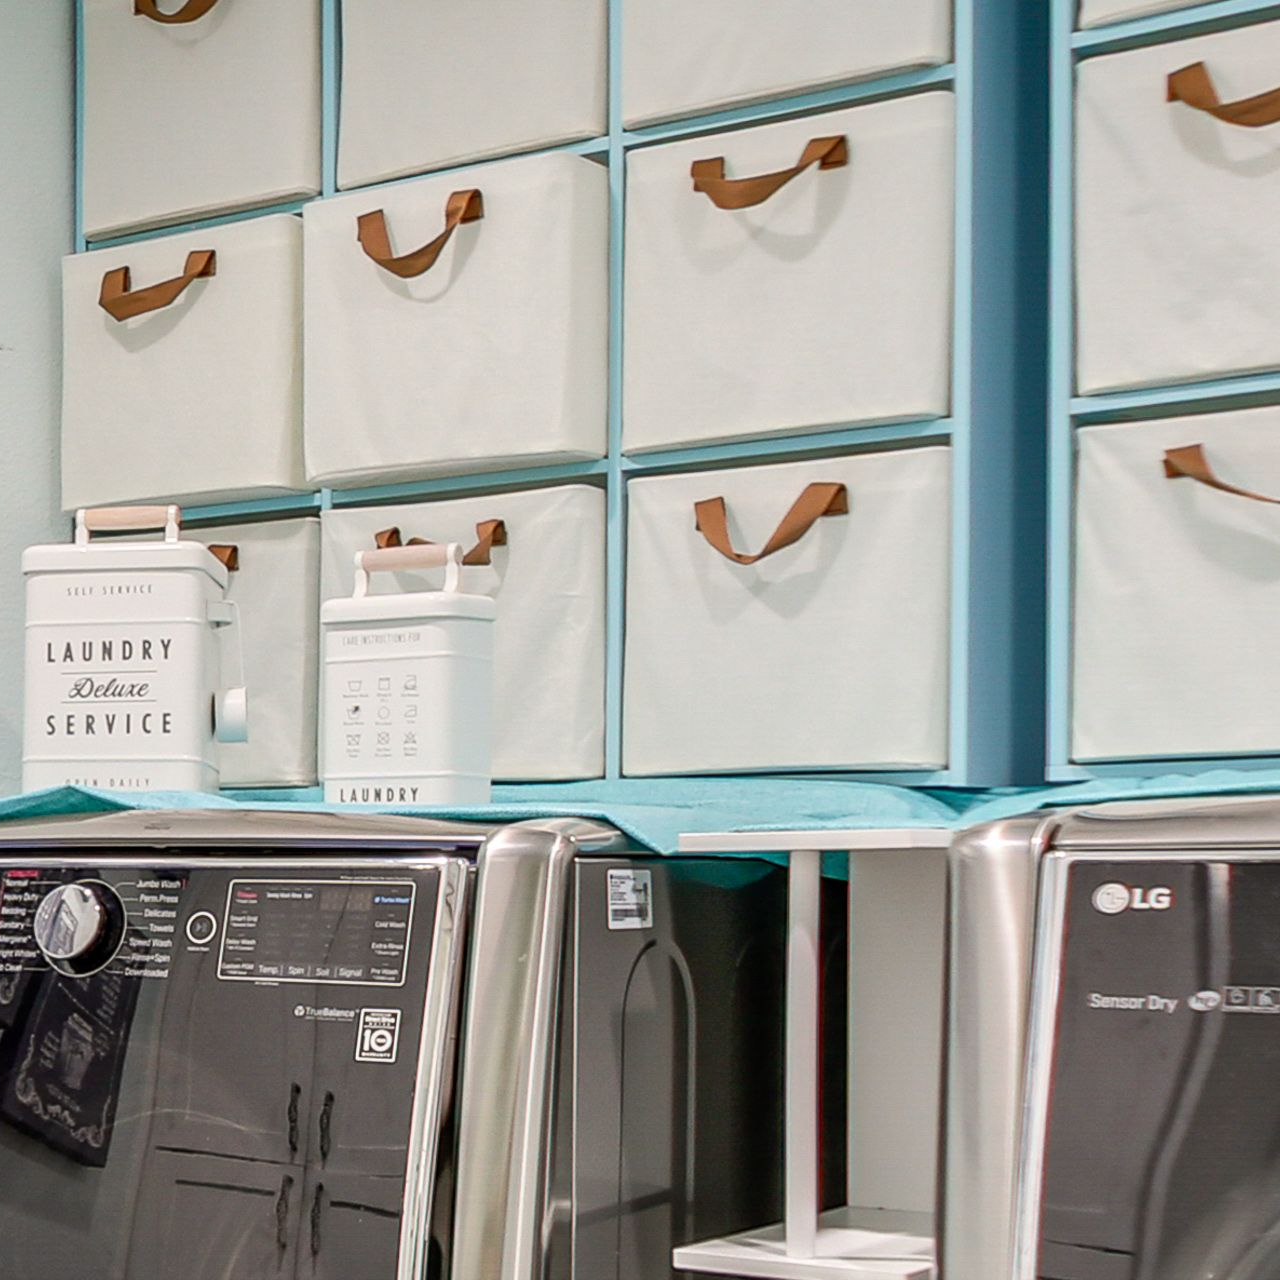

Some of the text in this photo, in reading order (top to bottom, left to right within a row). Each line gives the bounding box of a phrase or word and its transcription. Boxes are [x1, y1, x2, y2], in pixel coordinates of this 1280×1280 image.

[46, 638, 172, 663] LAUNDRY
[68, 677, 150, 699] Deluxe
[46, 712, 172, 736] SERVICE
[339, 786, 420, 803] LAUNDRY
[1130, 886, 1172, 910] LG
[1088, 992, 1179, 1013] Sensor Dry
[362, 1029, 393, 1052] 10
